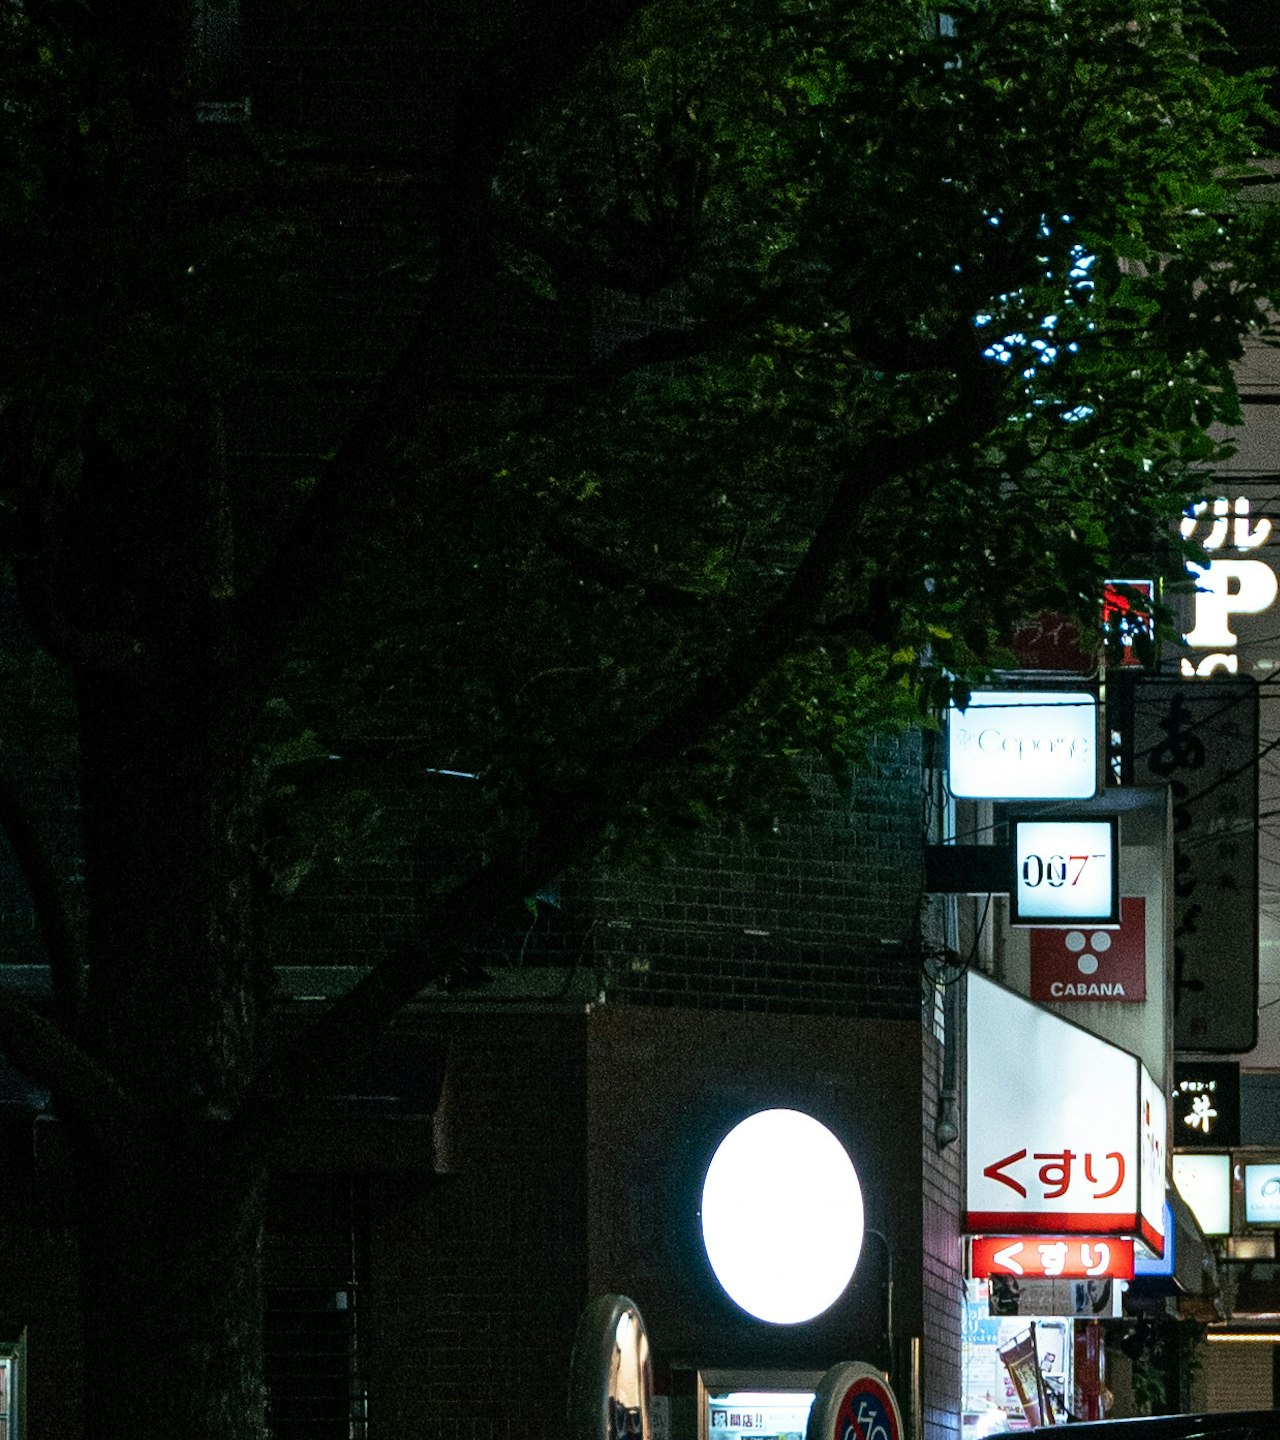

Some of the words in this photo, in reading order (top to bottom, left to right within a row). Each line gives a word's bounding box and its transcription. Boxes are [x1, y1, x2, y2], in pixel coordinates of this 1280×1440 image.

[1050, 981, 1126, 997] CABANA
[983, 1147, 1126, 1200] くすり
[993, 1240, 1111, 1276] くすり
